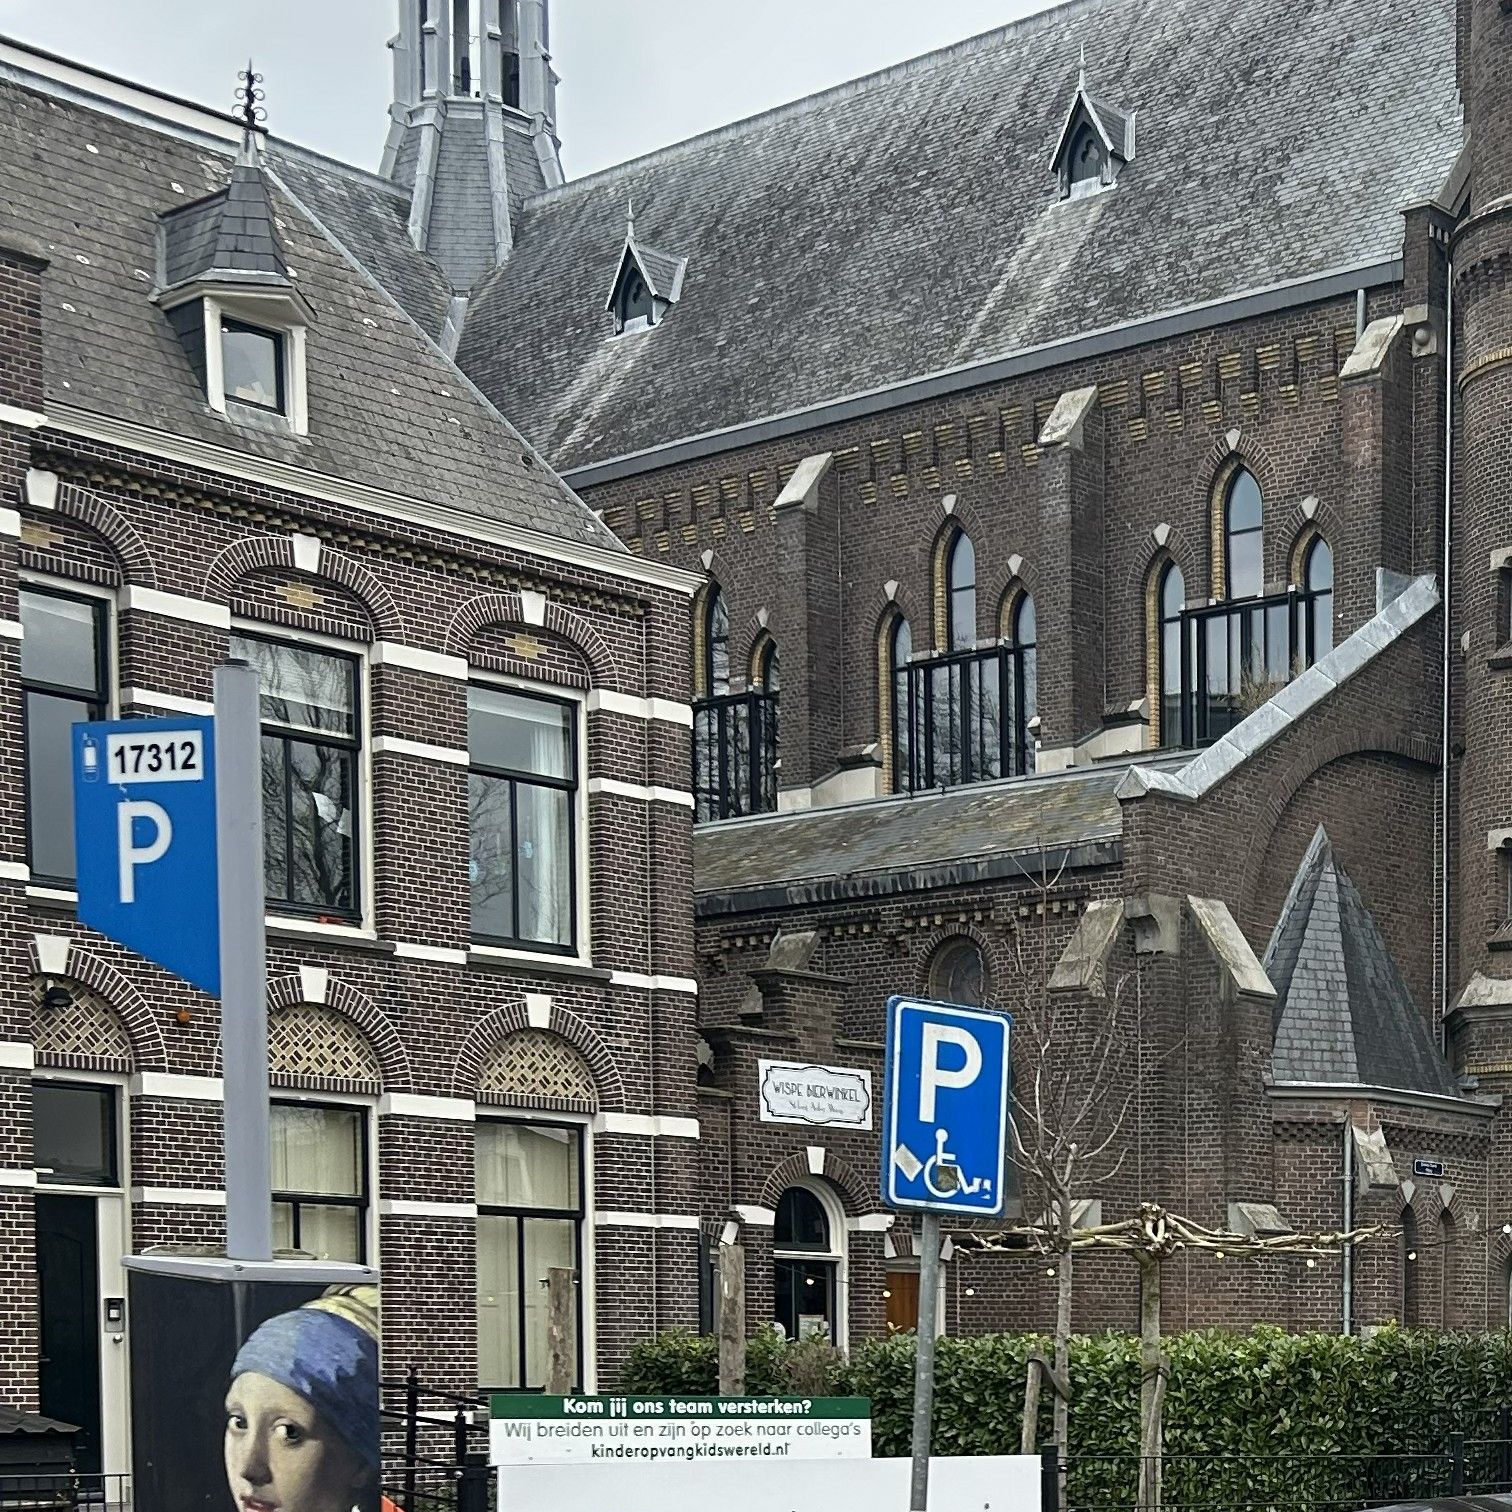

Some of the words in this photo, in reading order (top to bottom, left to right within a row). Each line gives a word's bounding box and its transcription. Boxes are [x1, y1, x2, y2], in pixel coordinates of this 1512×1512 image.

[114, 740, 197, 774] 17312
[116, 800, 173, 903] P
[918, 1021, 983, 1123] P
[771, 1080, 804, 1097] WISPE
[562, 1398, 604, 1414] Kom
[609, 1397, 628, 1418] jij
[632, 1399, 665, 1414] ons
[669, 1400, 713, 1414] team
[717, 1398, 812, 1414] versterken?
[503, 1422, 532, 1441] Wij
[536, 1422, 603, 1437] breiden
[608, 1422, 629, 1437] uit
[633, 1424, 654, 1437] en
[658, 1422, 686, 1440] zijn
[691, 1425, 711, 1440] op
[716, 1421, 752, 1436] zoek
[756, 1424, 792, 1436] naar
[591, 1442, 790, 1461] kinderopvangkidswereld.nl
